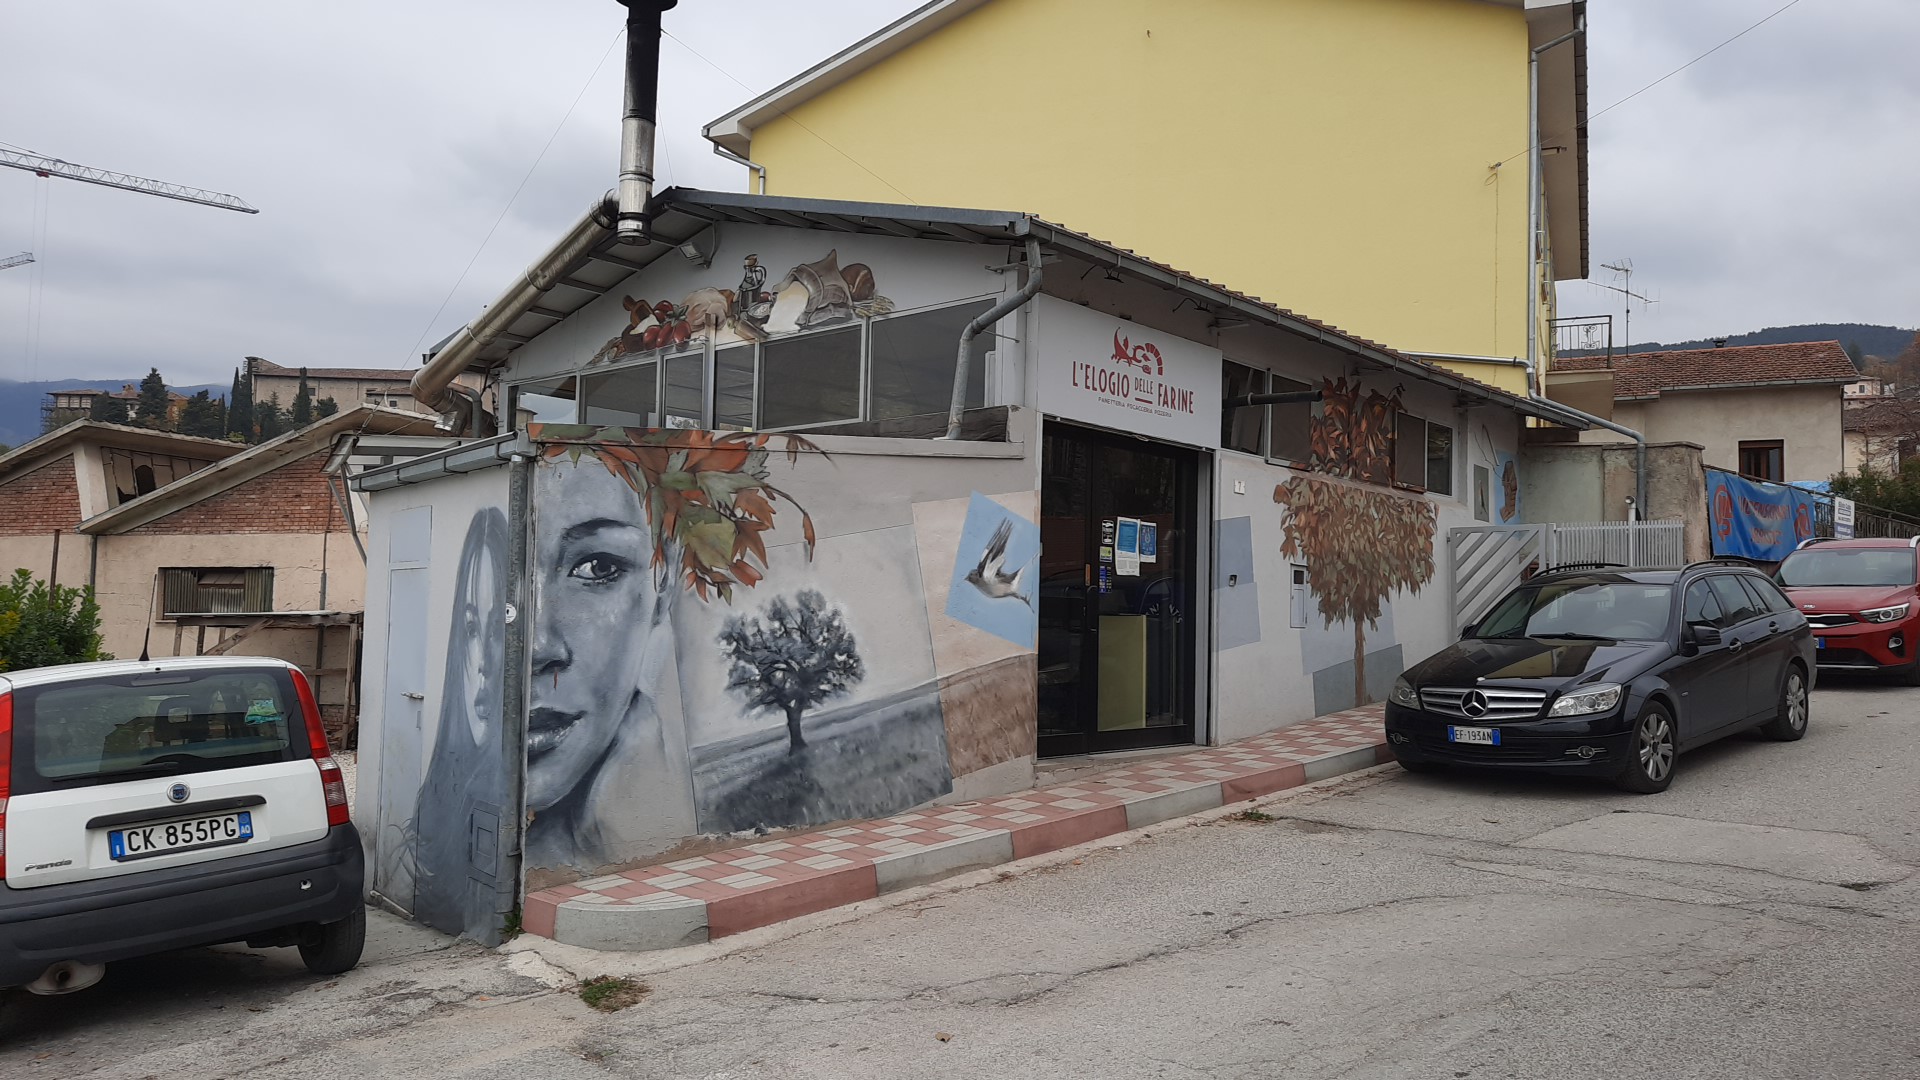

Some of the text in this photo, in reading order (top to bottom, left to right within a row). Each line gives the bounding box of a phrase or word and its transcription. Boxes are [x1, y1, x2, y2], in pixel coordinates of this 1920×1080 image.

[1073, 361, 1194, 414] L'ELOGIO DELLE FARINE
[127, 817, 237, 852] CK 855PG
